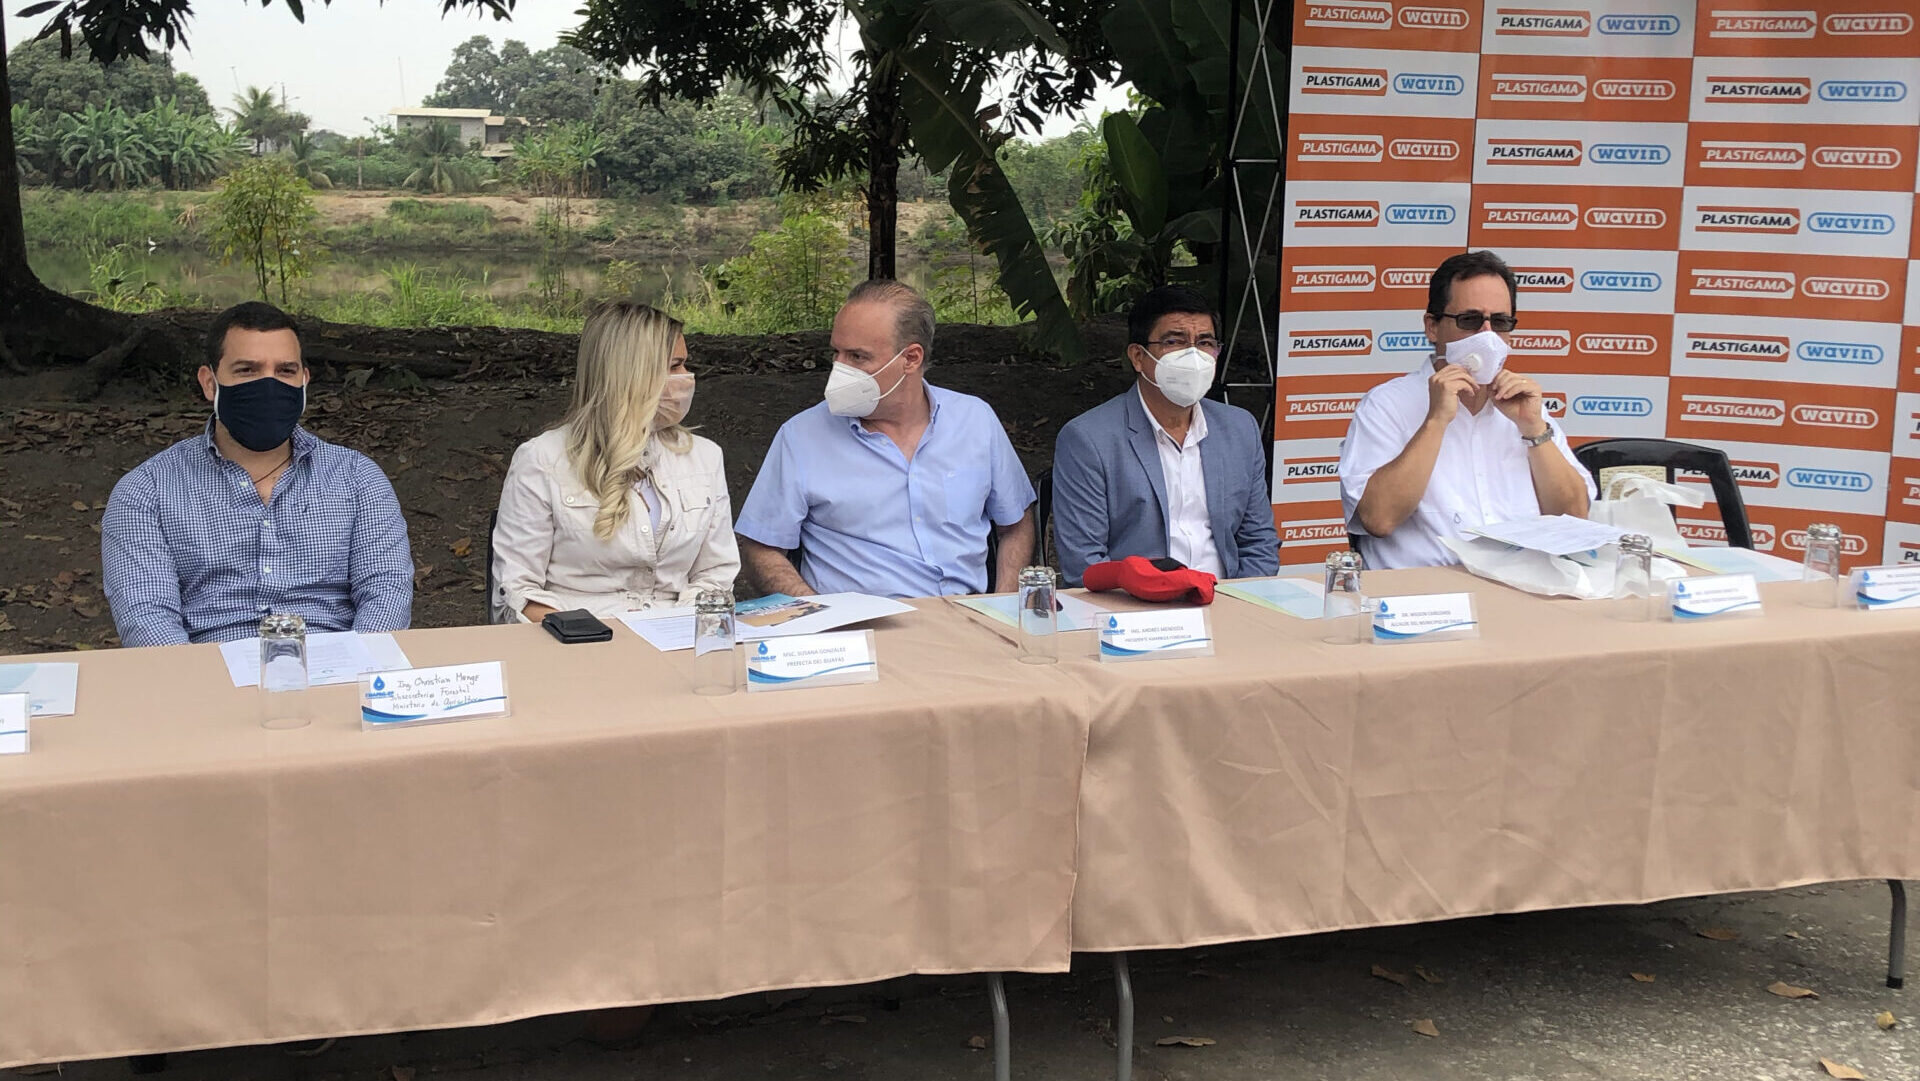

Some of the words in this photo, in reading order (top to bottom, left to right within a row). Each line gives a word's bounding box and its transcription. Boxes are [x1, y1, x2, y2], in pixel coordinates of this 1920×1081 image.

[1309, 7, 1386, 21] PLASTIGAMA
[1406, 10, 1461, 25] wavin
[1500, 16, 1583, 29] PLASTIGAMA
[1605, 17, 1671, 31] wavin
[1716, 19, 1808, 30] PLASTIGAMA
[1832, 17, 1905, 32] wavin
[1305, 75, 1381, 88] PLASTIGAMA
[1400, 78, 1457, 92] wavin
[1496, 82, 1579, 94] PLASTIGAMA
[1600, 82, 1667, 96] wavin
[1711, 84, 1802, 96] PLASTIGAMA
[1827, 84, 1898, 98] wavin
[1302, 142, 1377, 155] PLASTIGAMA
[1395, 143, 1451, 157] wavin
[1492, 147, 1575, 159] PLASTIGAMA
[1597, 148, 1662, 161] wavin
[1705, 149, 1797, 162] PLASTIGAMA
[1821, 150, 1892, 165] wavin
[1299, 208, 1373, 221] PLASTIGAMA
[1391, 208, 1448, 221] wavin
[1487, 211, 1570, 223] PLASTIGAMA
[1592, 211, 1658, 225] wavin
[1701, 214, 1792, 227] PLASTIGAMA
[1816, 215, 1887, 230] wavin
[1296, 273, 1370, 285] PLASTIGAMA
[1387, 272, 1431, 285] wavi
[1515, 274, 1566, 286] TIGAMA
[1589, 274, 1654, 288] wavin
[1696, 277, 1787, 291] PLASTIGAMA
[1811, 281, 1881, 296] wavin
[1292, 337, 1366, 349] PLASTIGAMA
[1385, 335, 1434, 348] wavi
[1512, 336, 1563, 349] TIGAMA
[1584, 337, 1649, 351] wavin
[1691, 341, 1782, 355] PLASTIGAMA
[1806, 345, 1875, 361] wavin
[1290, 401, 1357, 414] PLASTIGAM
[1581, 400, 1644, 412] wavin
[1686, 403, 1777, 419] PLASTIGAMA
[1800, 408, 1870, 425] wavin
[1796, 471, 1863, 488] wavin
[1285, 526, 1347, 539] PLASTIGAM
